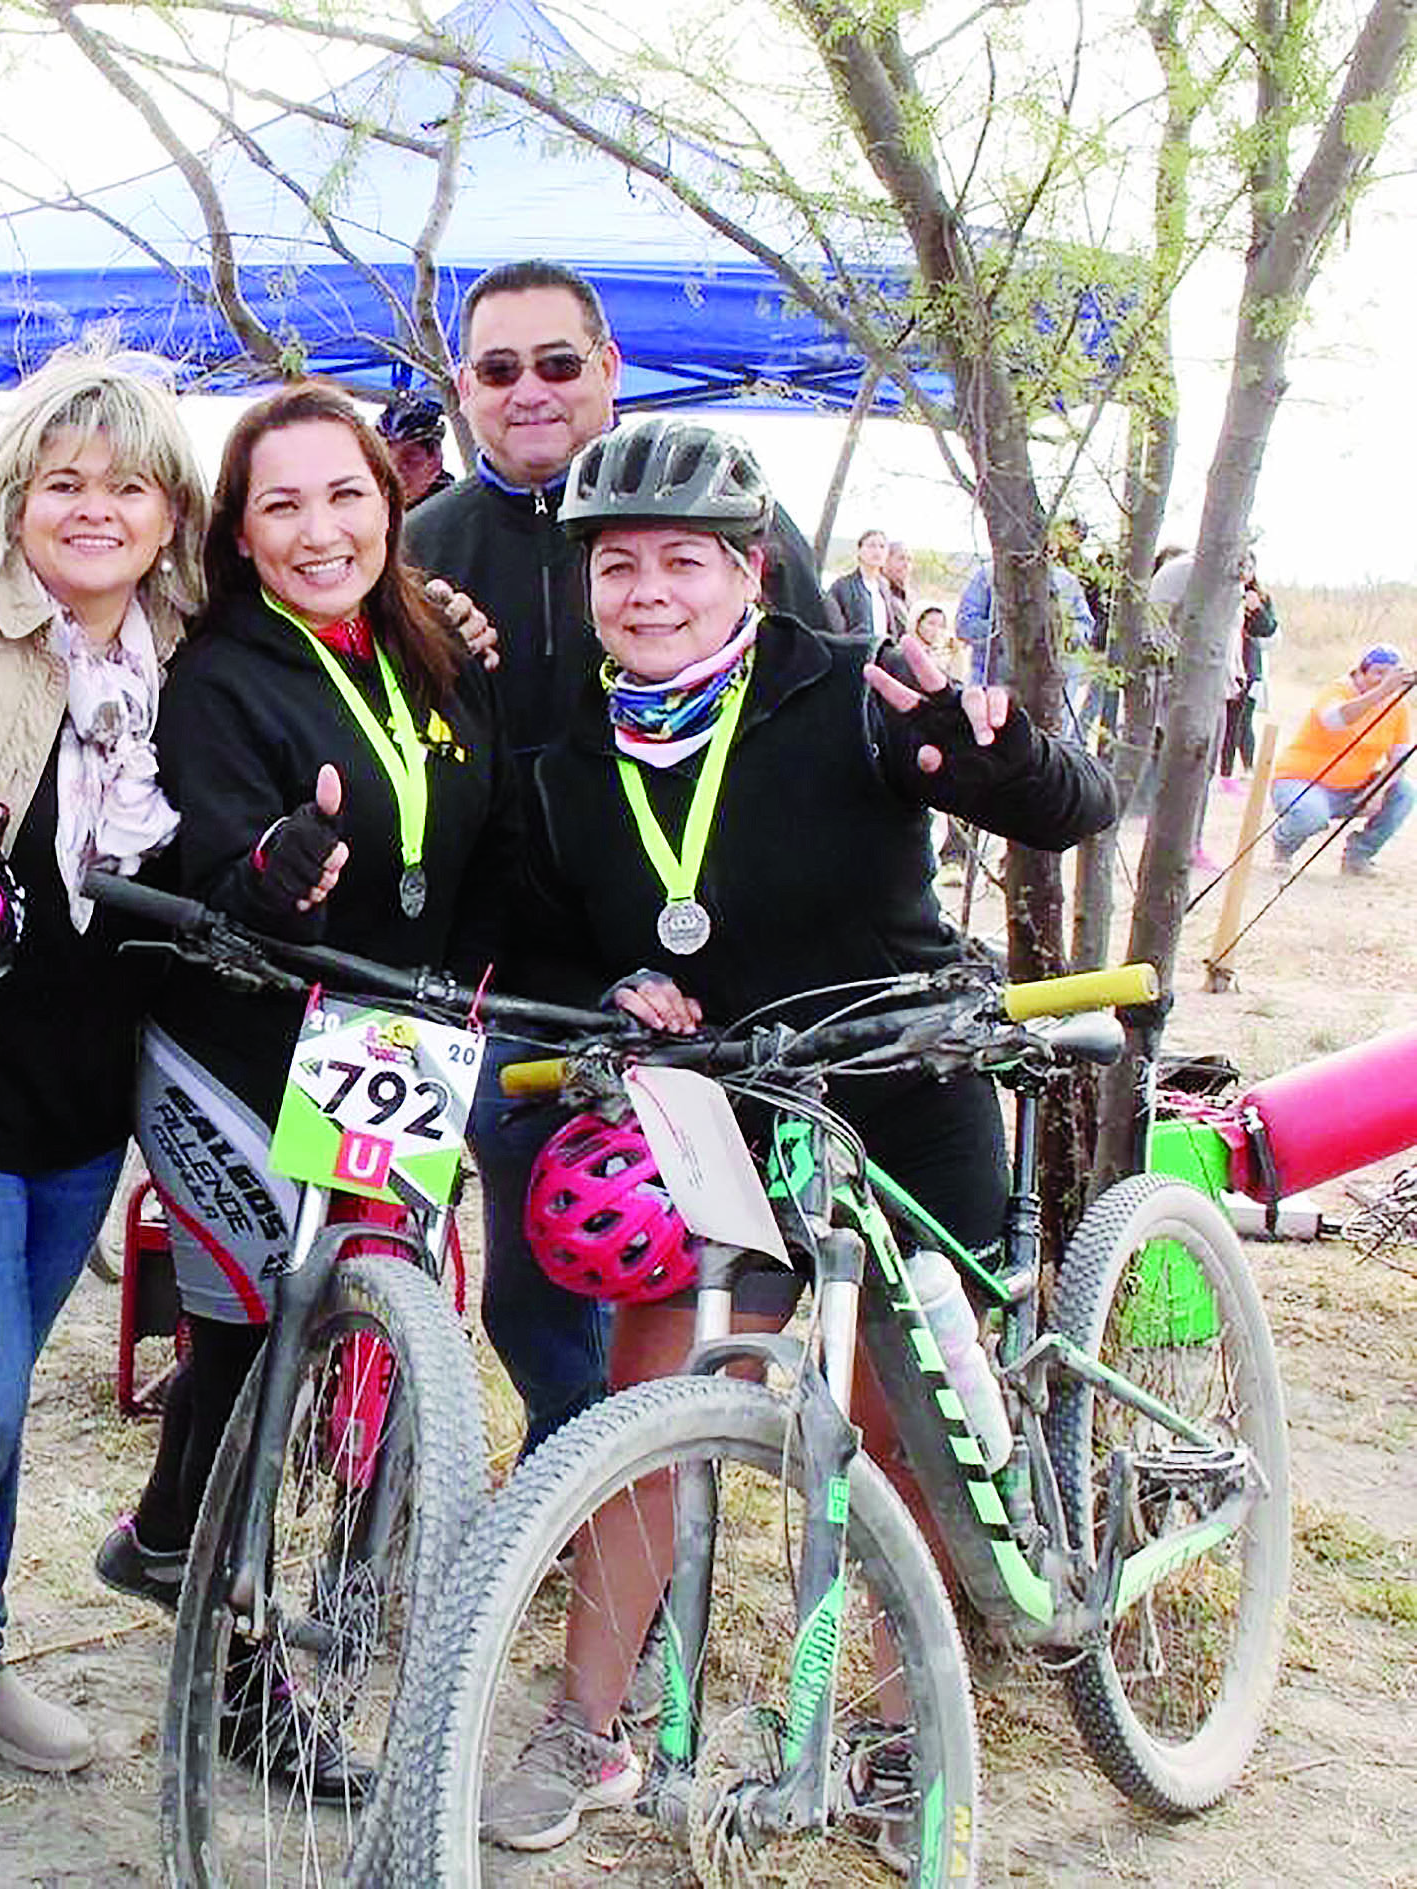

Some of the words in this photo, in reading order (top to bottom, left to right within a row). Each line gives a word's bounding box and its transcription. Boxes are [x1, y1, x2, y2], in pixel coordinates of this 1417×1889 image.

[448, 1044, 476, 1066] 20
[322, 1059, 449, 1141] 792
[155, 1103, 253, 1235] ALLENDE
[348, 1138, 382, 1179] U
